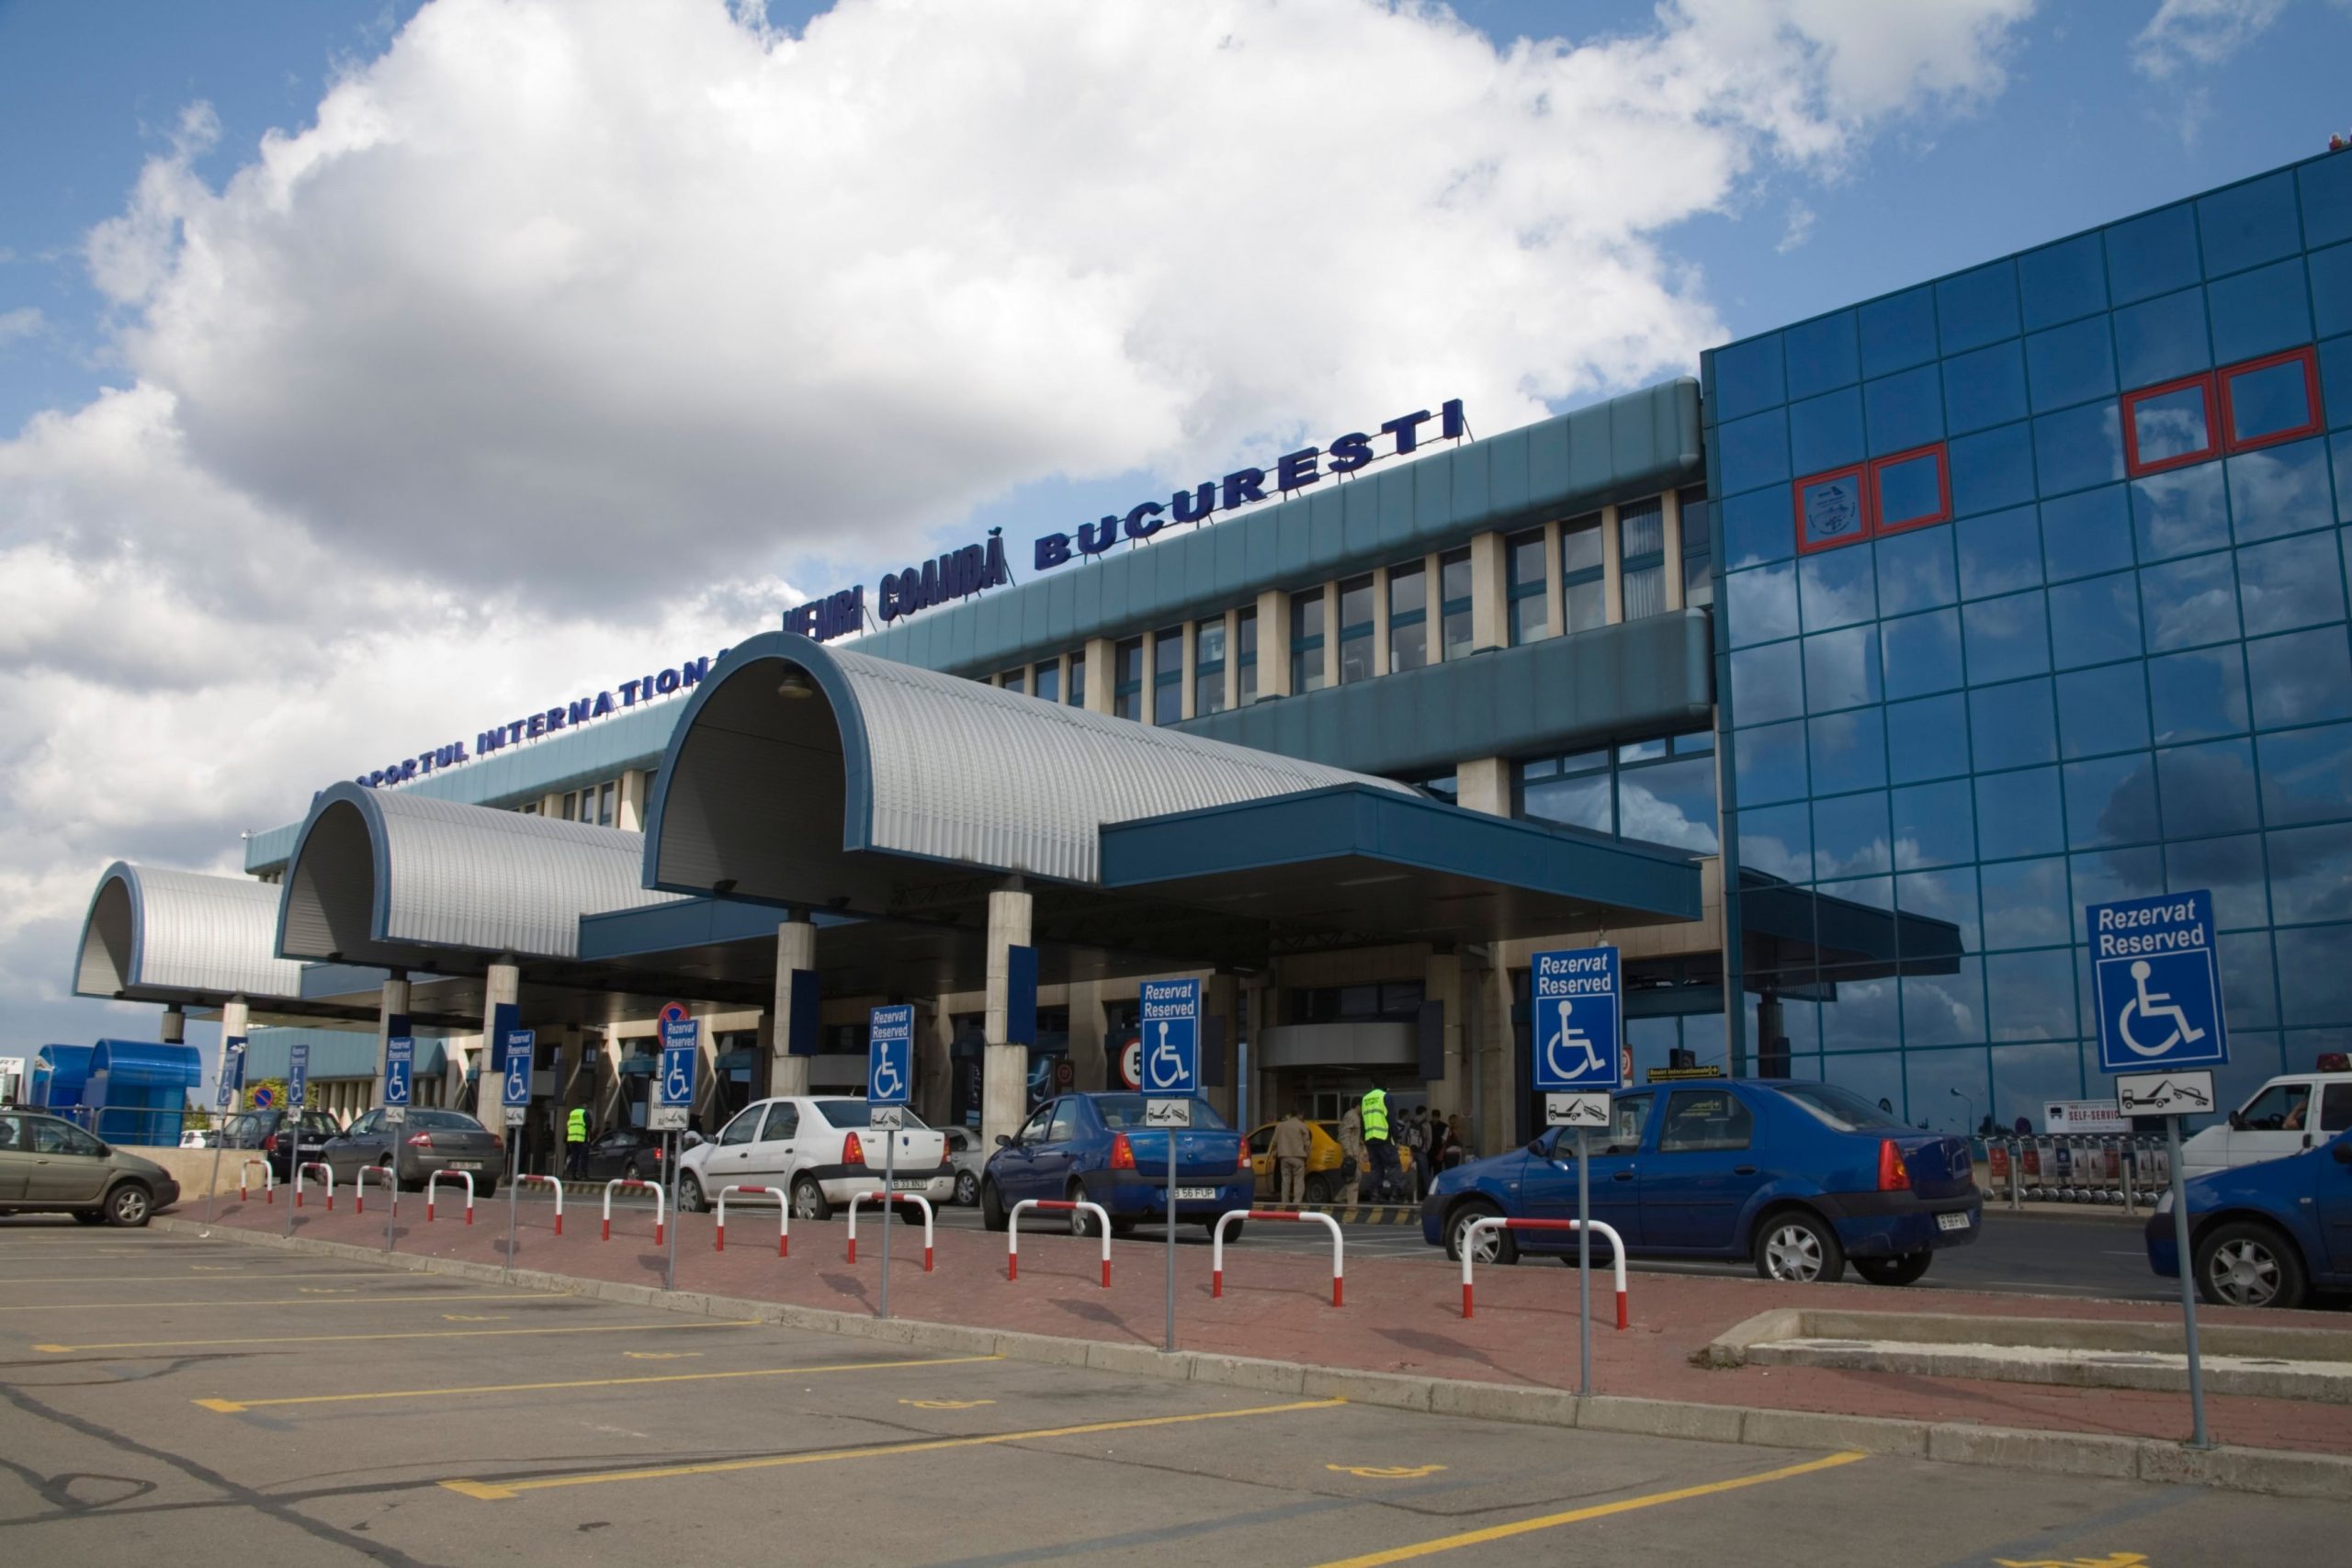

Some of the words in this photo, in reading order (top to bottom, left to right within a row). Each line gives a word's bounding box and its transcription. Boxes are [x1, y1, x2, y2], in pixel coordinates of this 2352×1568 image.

[783, 584, 864, 643] HENRI
[1035, 399, 1464, 570] BUCURESTI
[2098, 898, 2196, 931] Rezervat
[2099, 922, 2205, 956] Reserved
[1540, 953, 1608, 975] Rezervat
[1145, 983, 1193, 1000] Rezervat
[1539, 972, 1611, 995] Reserved
[874, 1009, 908, 1024] Rezervat
[1144, 999, 1194, 1018] Reserved
[668, 1021, 695, 1034] Rezervat
[873, 1022, 909, 1039] Reserved
[666, 1035, 695, 1048] Reserved
[2068, 1110, 2124, 1121] SELF-SERVIC
